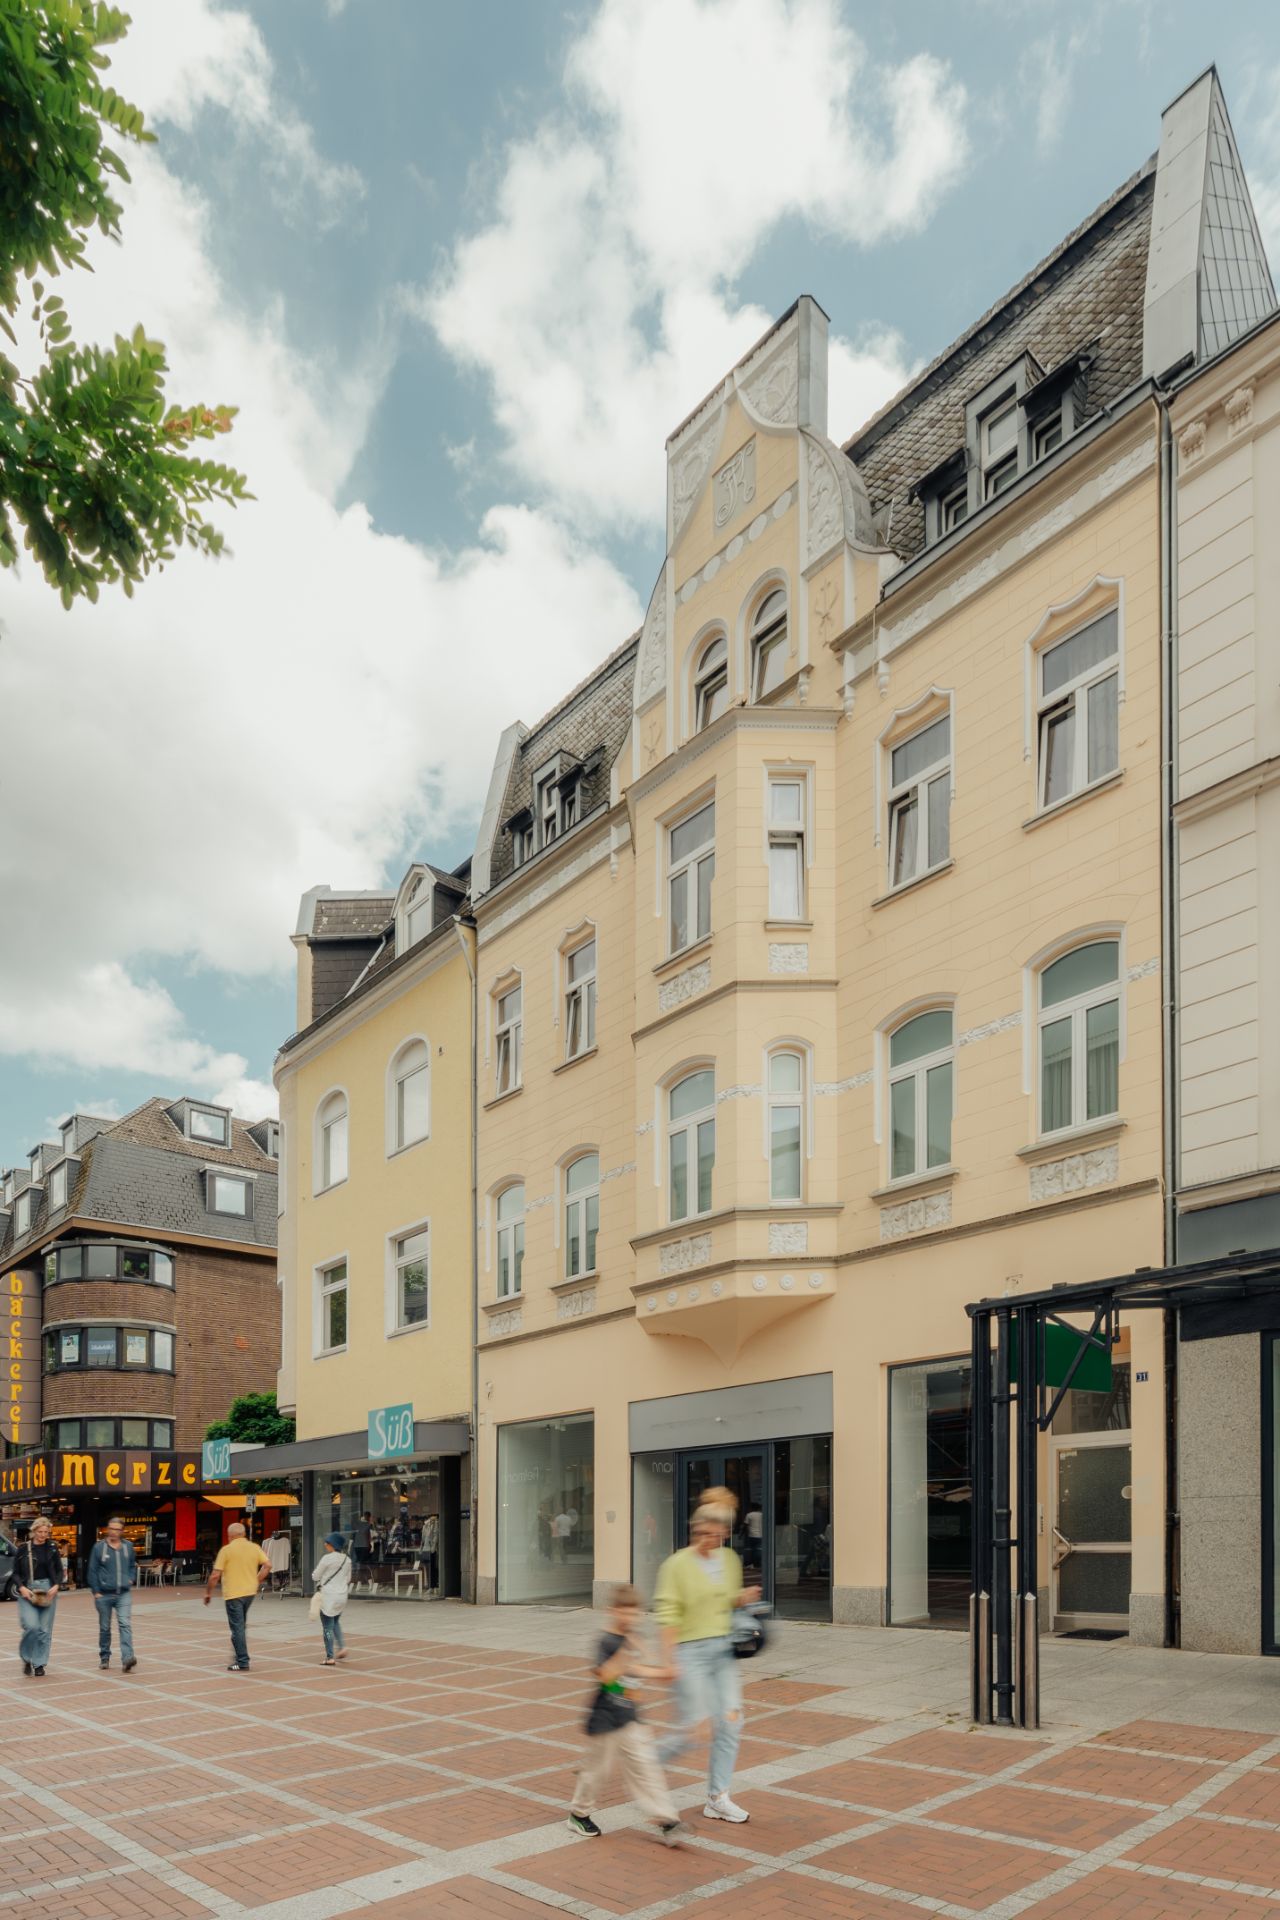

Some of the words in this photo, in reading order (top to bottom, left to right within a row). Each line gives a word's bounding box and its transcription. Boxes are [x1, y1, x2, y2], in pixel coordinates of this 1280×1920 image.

[9, 1271, 24, 1443] bäckerei
[368, 1410, 412, 1457] Süß
[203, 1443, 230, 1478] Süß
